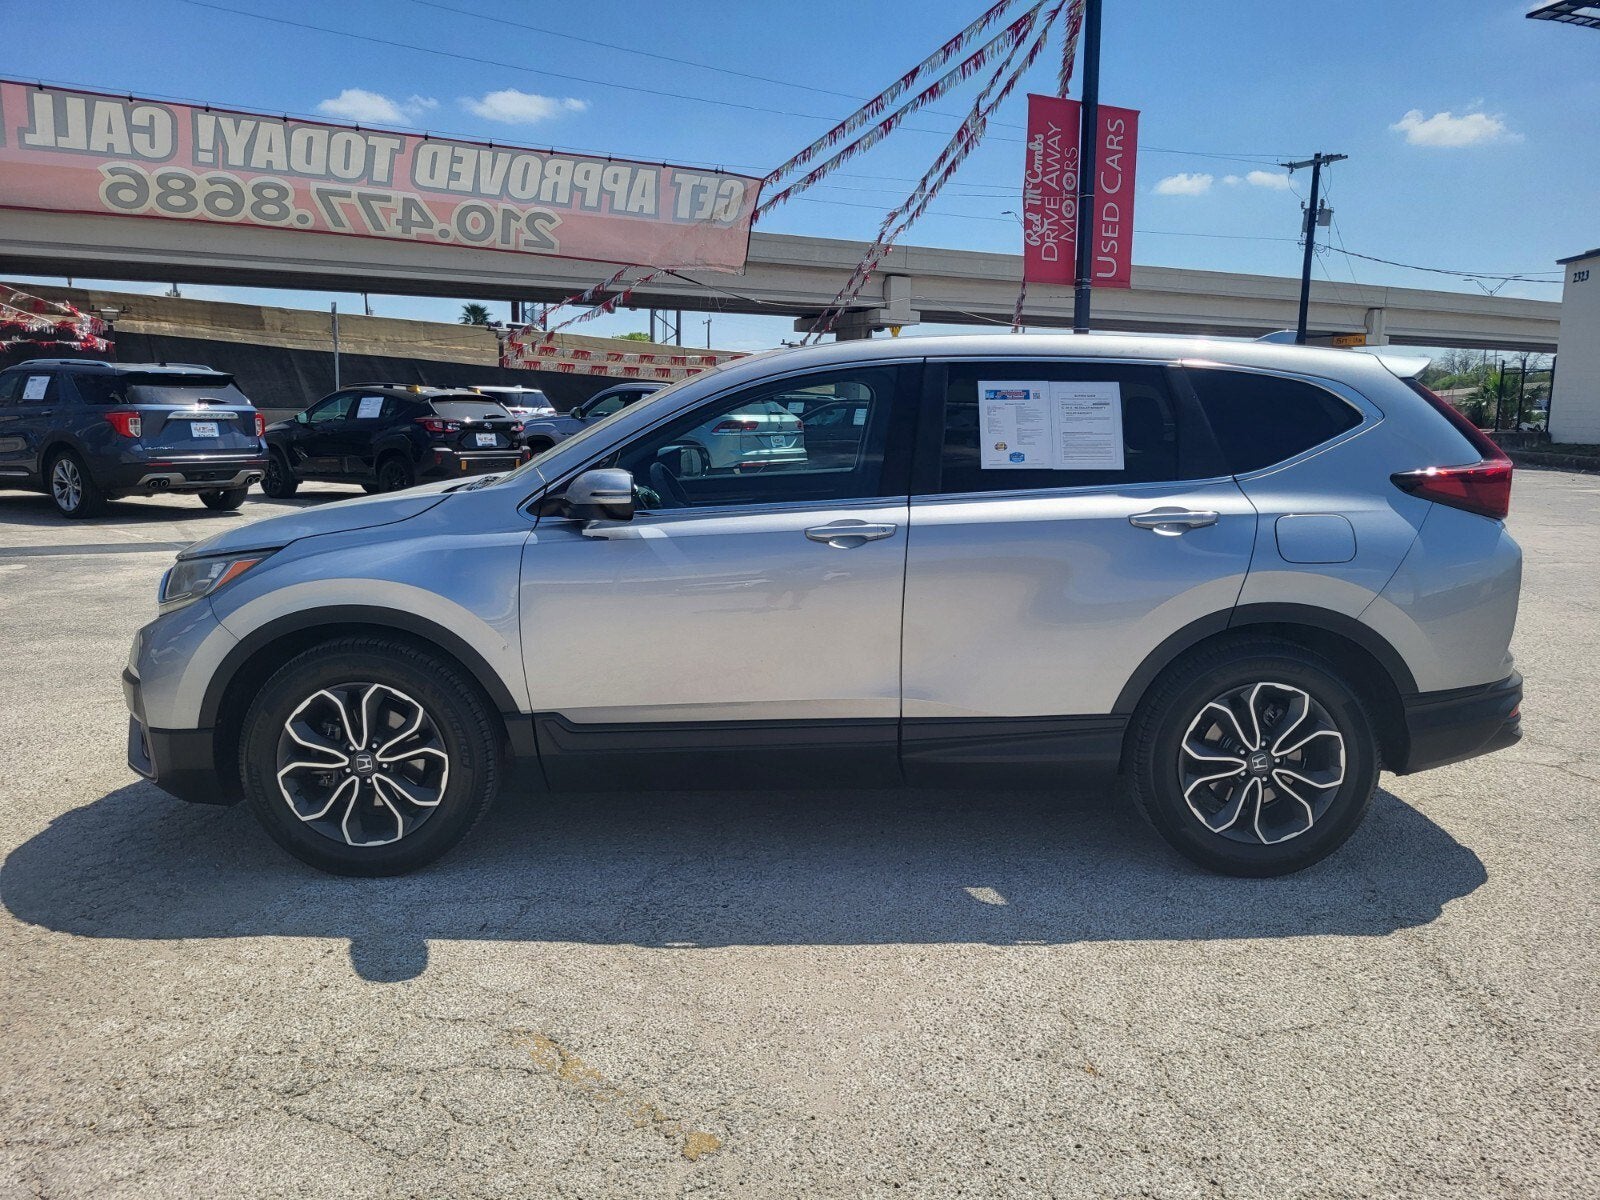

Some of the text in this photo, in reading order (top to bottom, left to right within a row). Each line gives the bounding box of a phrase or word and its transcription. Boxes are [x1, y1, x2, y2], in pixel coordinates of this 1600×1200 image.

[1025, 213, 1048, 247] Red
[1041, 121, 1062, 262] DRIVE AWAY
[1059, 146, 1078, 243] MOTORS
[1096, 118, 1125, 278] USED CARS
[1572, 269, 1590, 283] 2323
